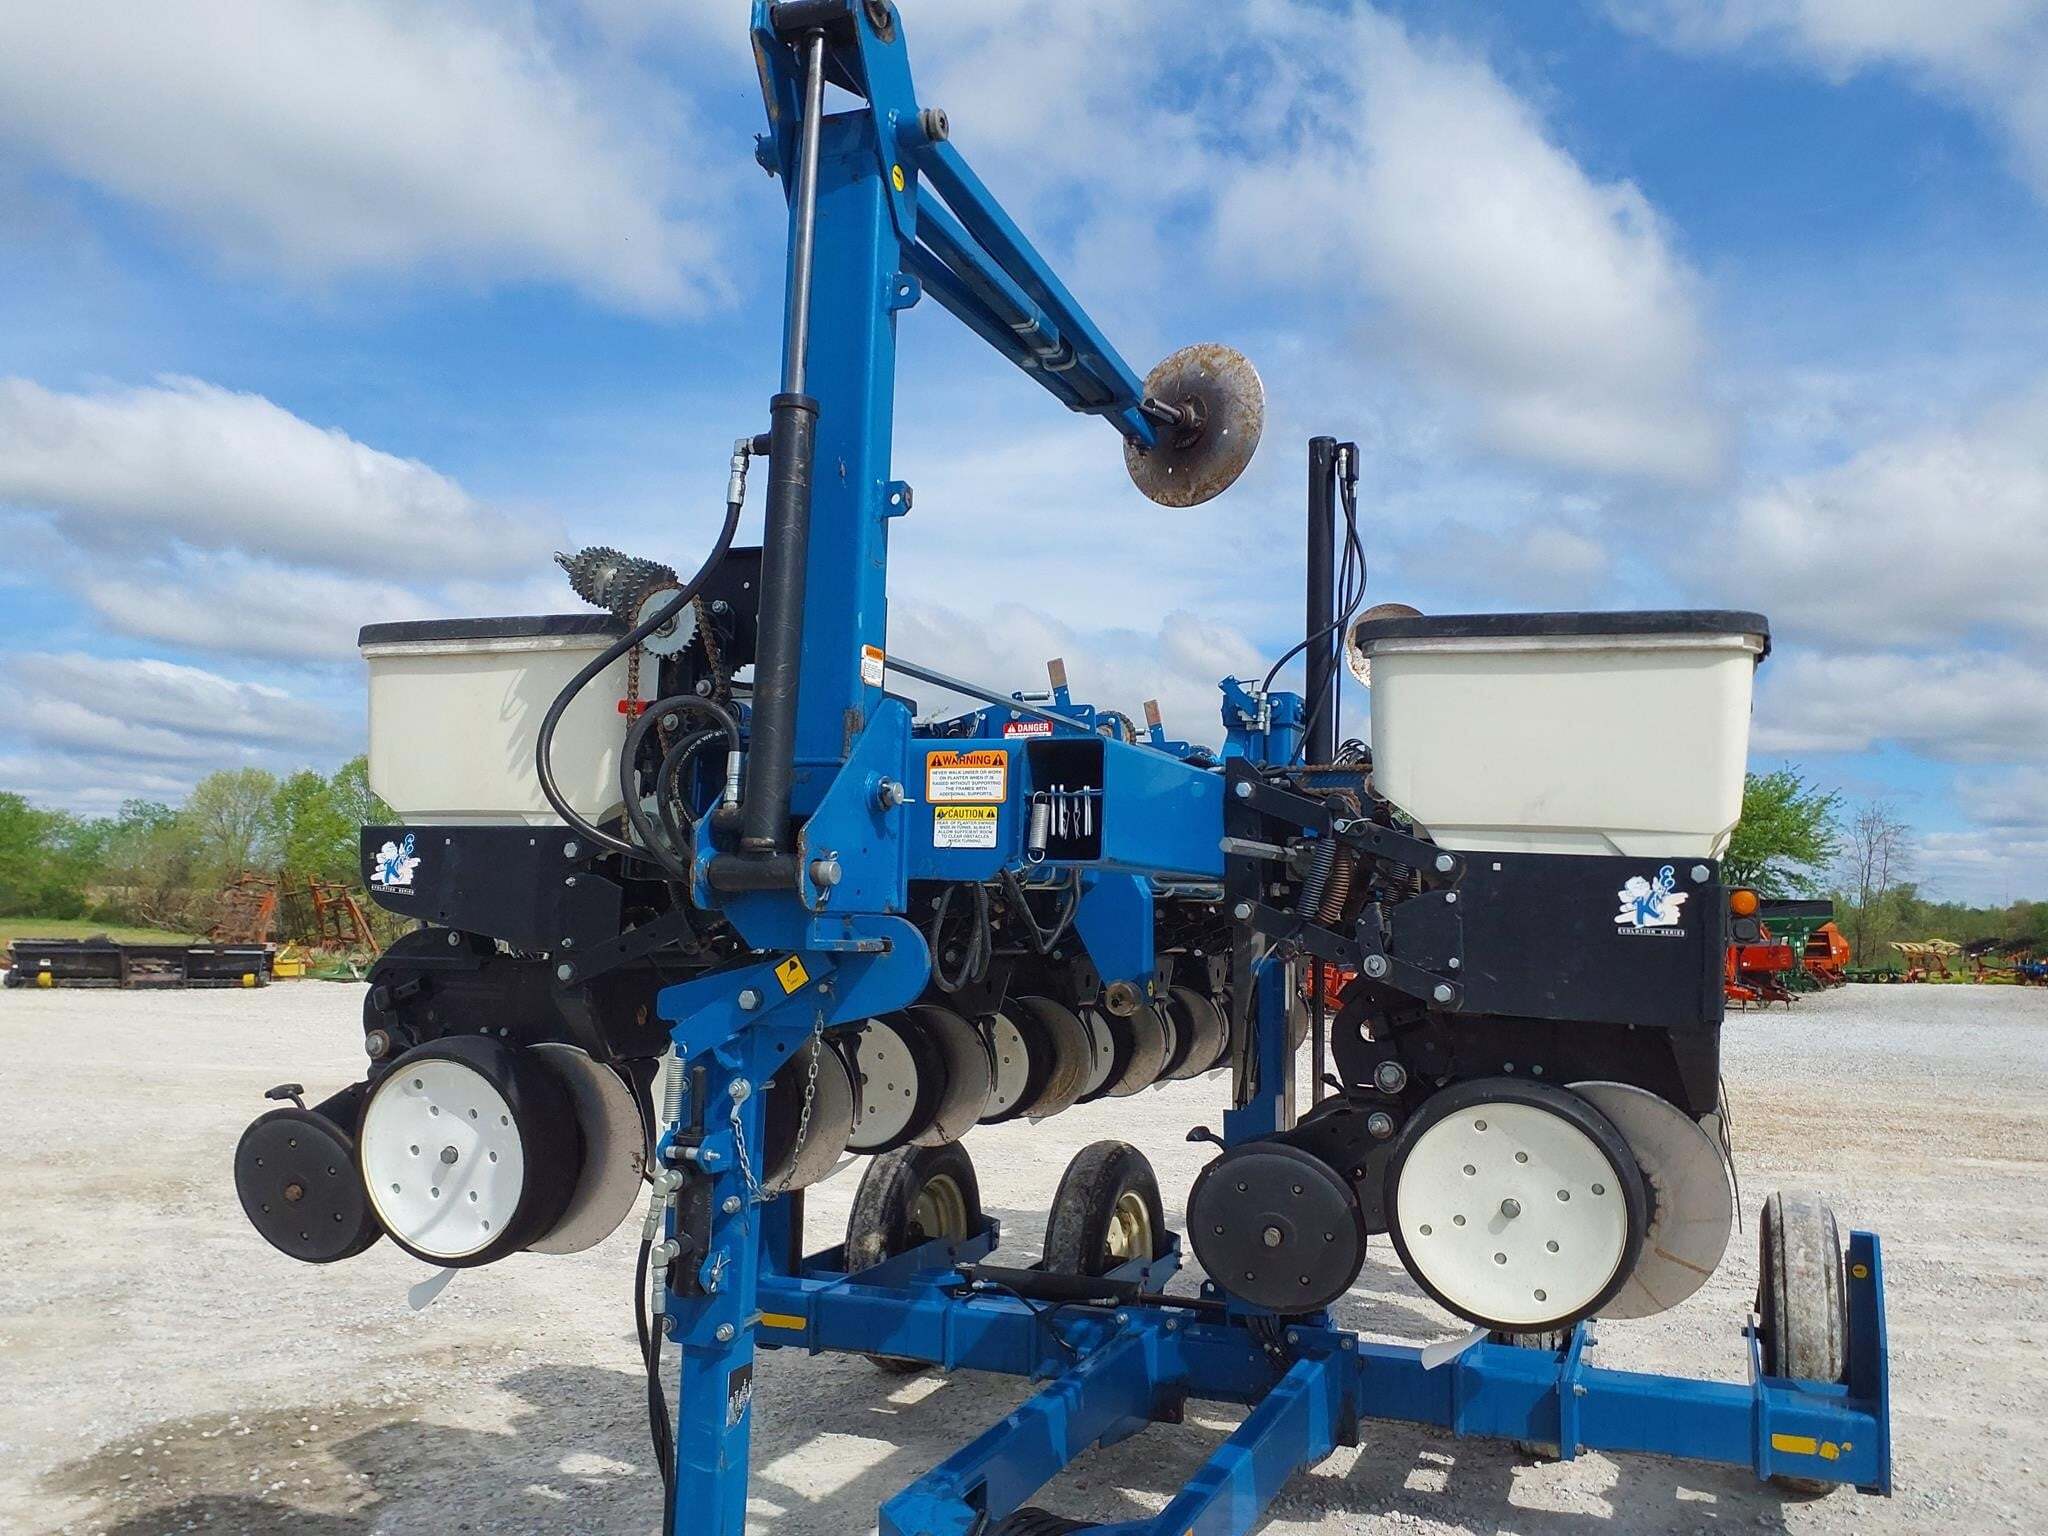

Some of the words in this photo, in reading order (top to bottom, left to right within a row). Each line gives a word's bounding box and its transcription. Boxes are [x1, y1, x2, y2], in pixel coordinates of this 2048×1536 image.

[1017, 723, 1049, 732] DANGER
[942, 755, 991, 765] WARNING
[948, 809, 984, 818] CAUTION
